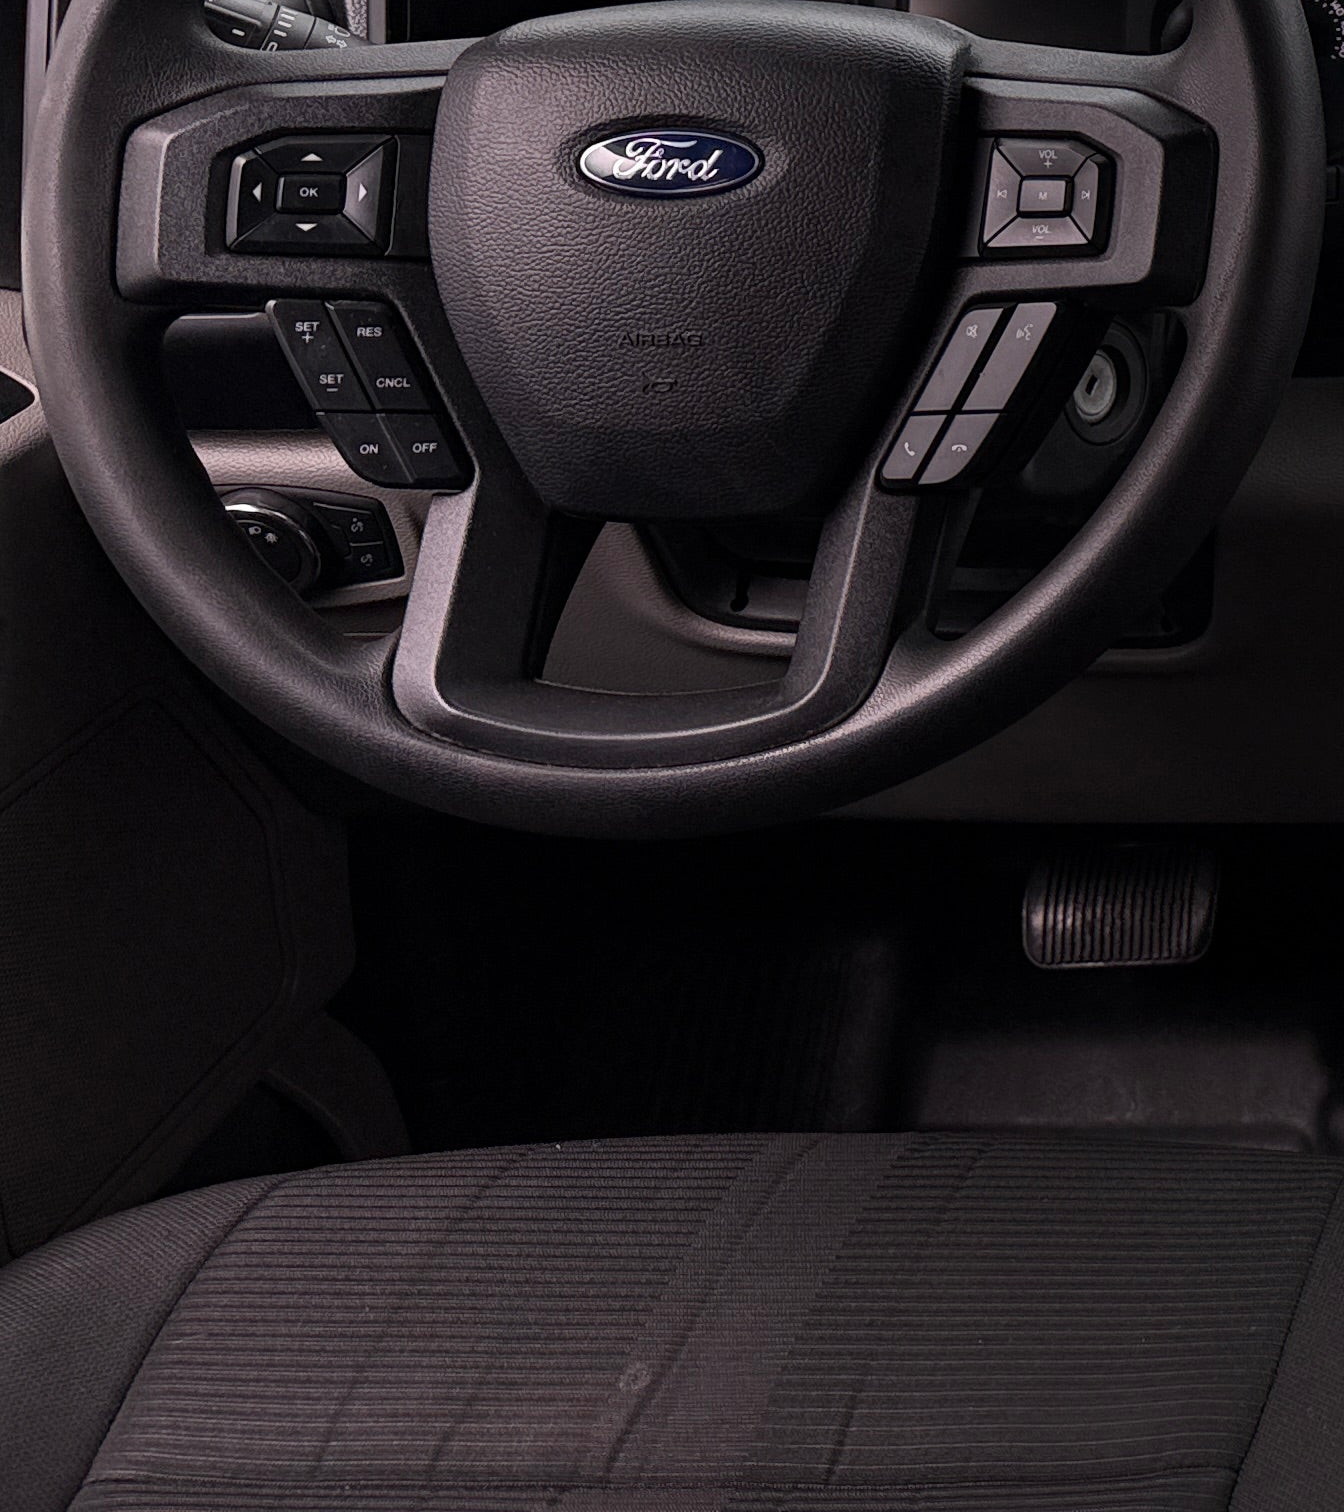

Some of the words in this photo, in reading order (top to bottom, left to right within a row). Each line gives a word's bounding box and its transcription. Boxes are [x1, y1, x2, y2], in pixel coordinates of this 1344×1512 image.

[1330, 0, 1344, 16] 140
[612, 137, 723, 182] Ford
[1039, 150, 1058, 159] VOL
[299, 187, 318, 198] OK
[1031, 224, 1051, 234] VOL
[295, 321, 320, 332] SET
[356, 326, 382, 337] RES
[619, 332, 703, 346] AIRBAG
[319, 374, 344, 385] SET
[375, 377, 411, 388] CNCL
[359, 443, 379, 455] ON
[412, 442, 438, 454] OFF
